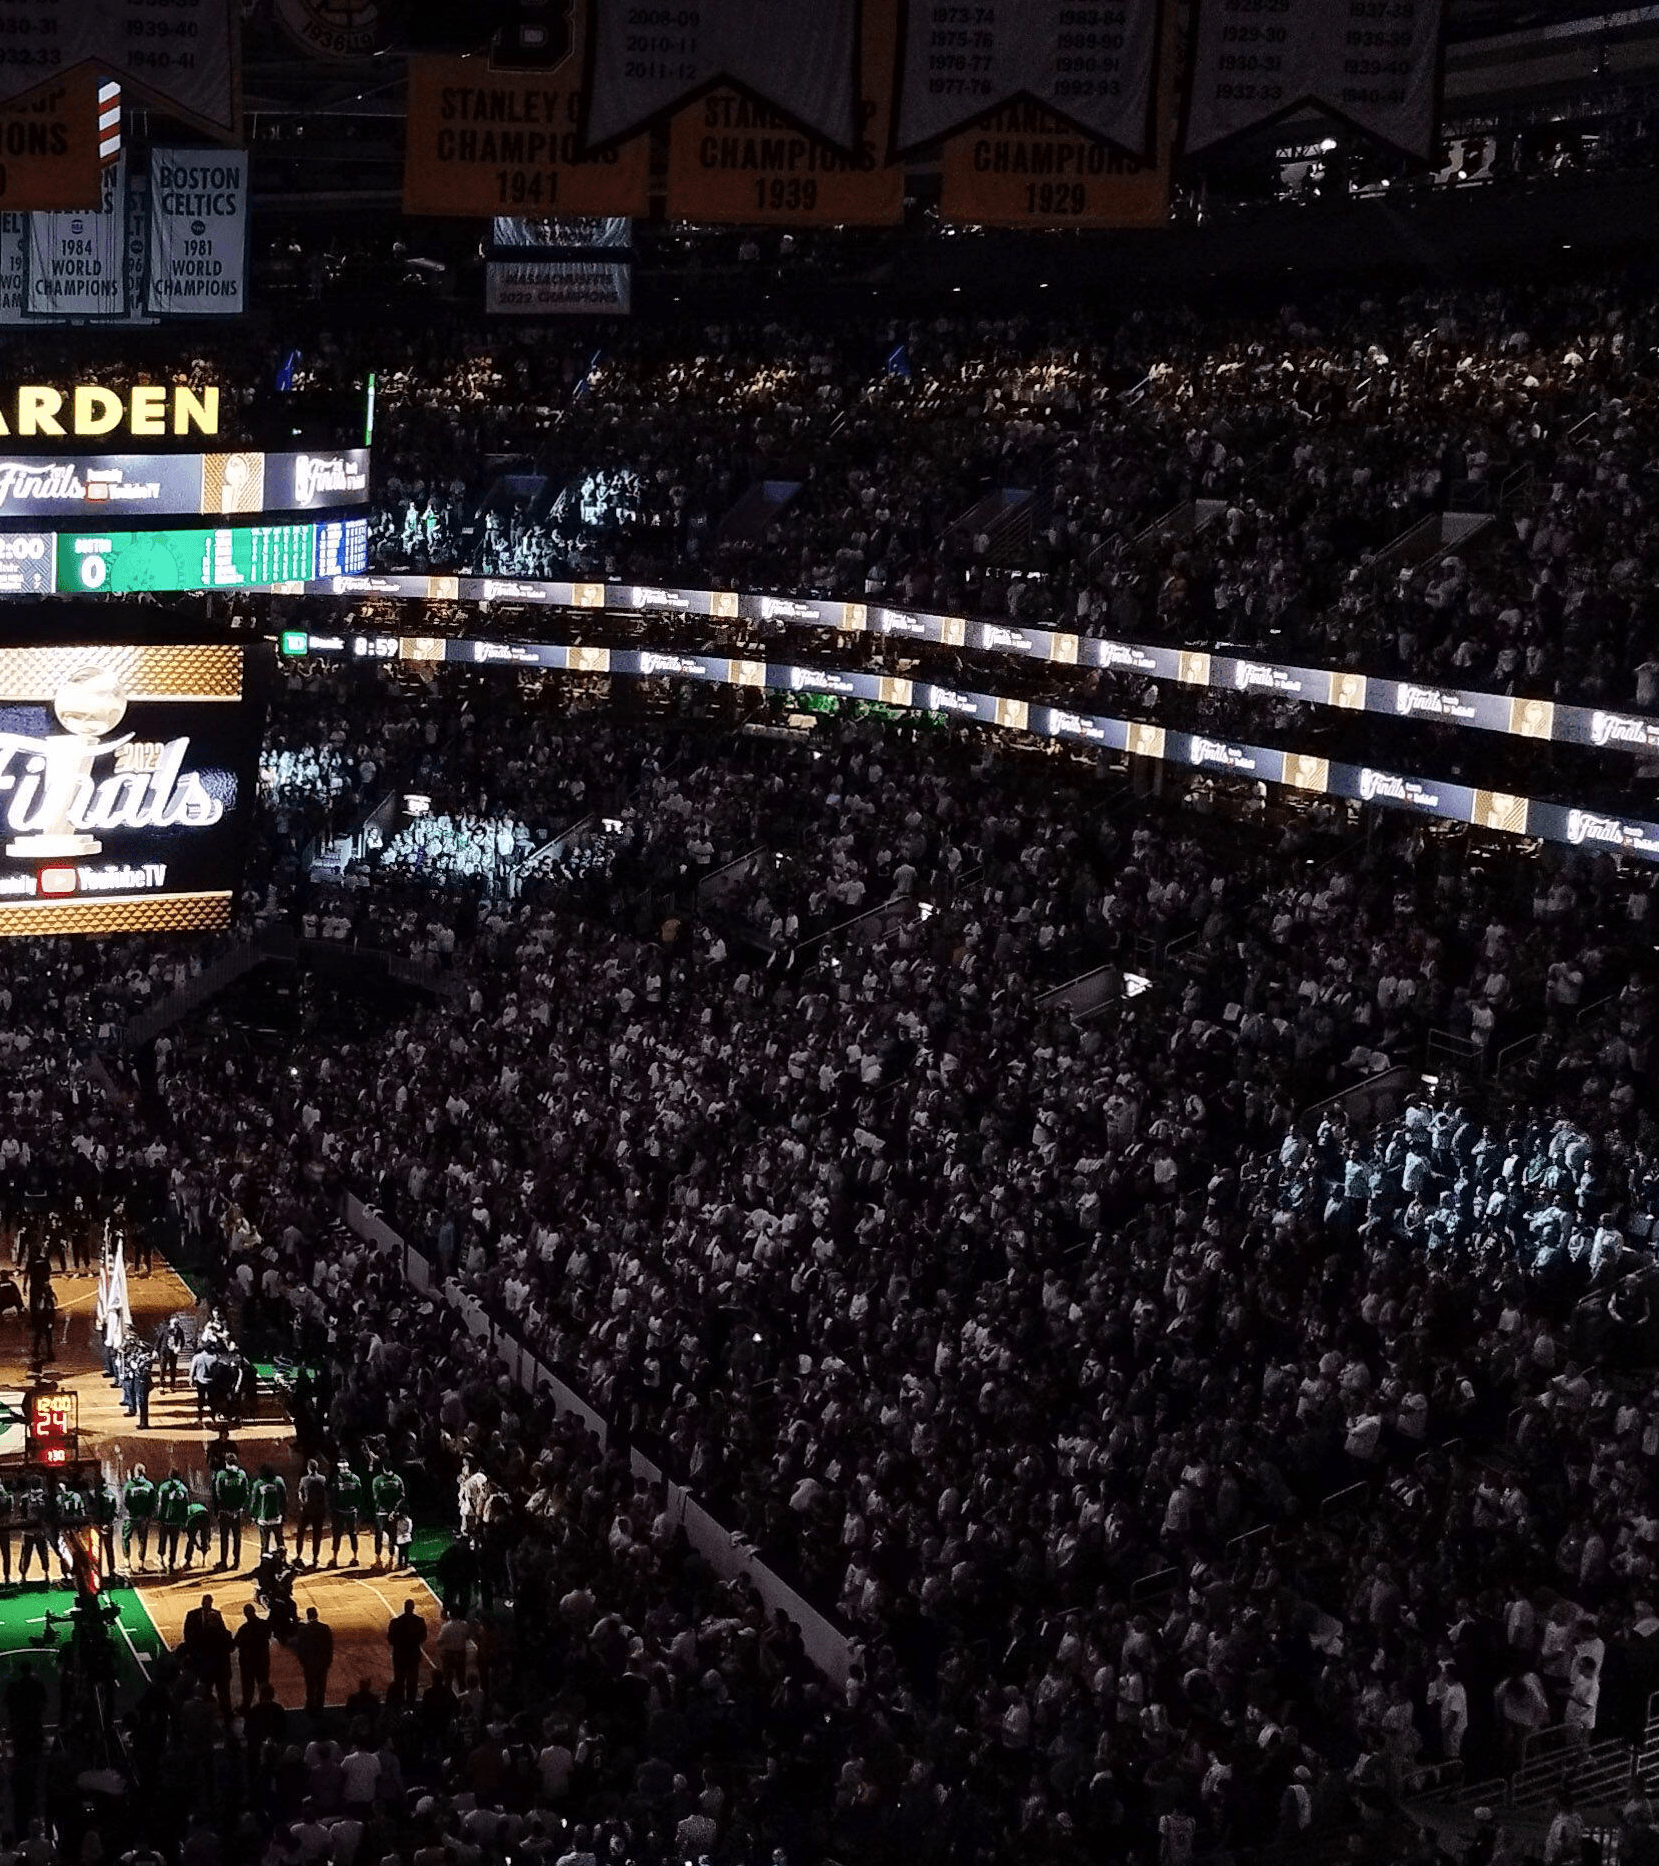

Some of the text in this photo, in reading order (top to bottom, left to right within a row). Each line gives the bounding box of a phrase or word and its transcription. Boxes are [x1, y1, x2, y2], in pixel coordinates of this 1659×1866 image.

[628, 9, 701, 28] 2008-09
[126, 19, 199, 38] 1939-40
[627, 36, 697, 54] 2010-11
[126, 50, 196, 70] 1940-41
[441, 87, 558, 123] STANLEY
[161, 167, 240, 190] BOSTON
[496, 170, 558, 204] 1941
[755, 178, 818, 210] 1939
[1025, 182, 1086, 214] 1929
[163, 193, 236, 216] CELTICS
[61, 239, 93, 256] 1984
[183, 240, 212, 257] 1981
[52, 260, 102, 276] WORLD
[173, 260, 222, 276] WORLD
[35, 280, 118, 296] CHAMPIONS
[155, 280, 237, 297] CHAMPIONS
[81, 555, 107, 589] 0
[36, 1412, 68, 1436] 24
